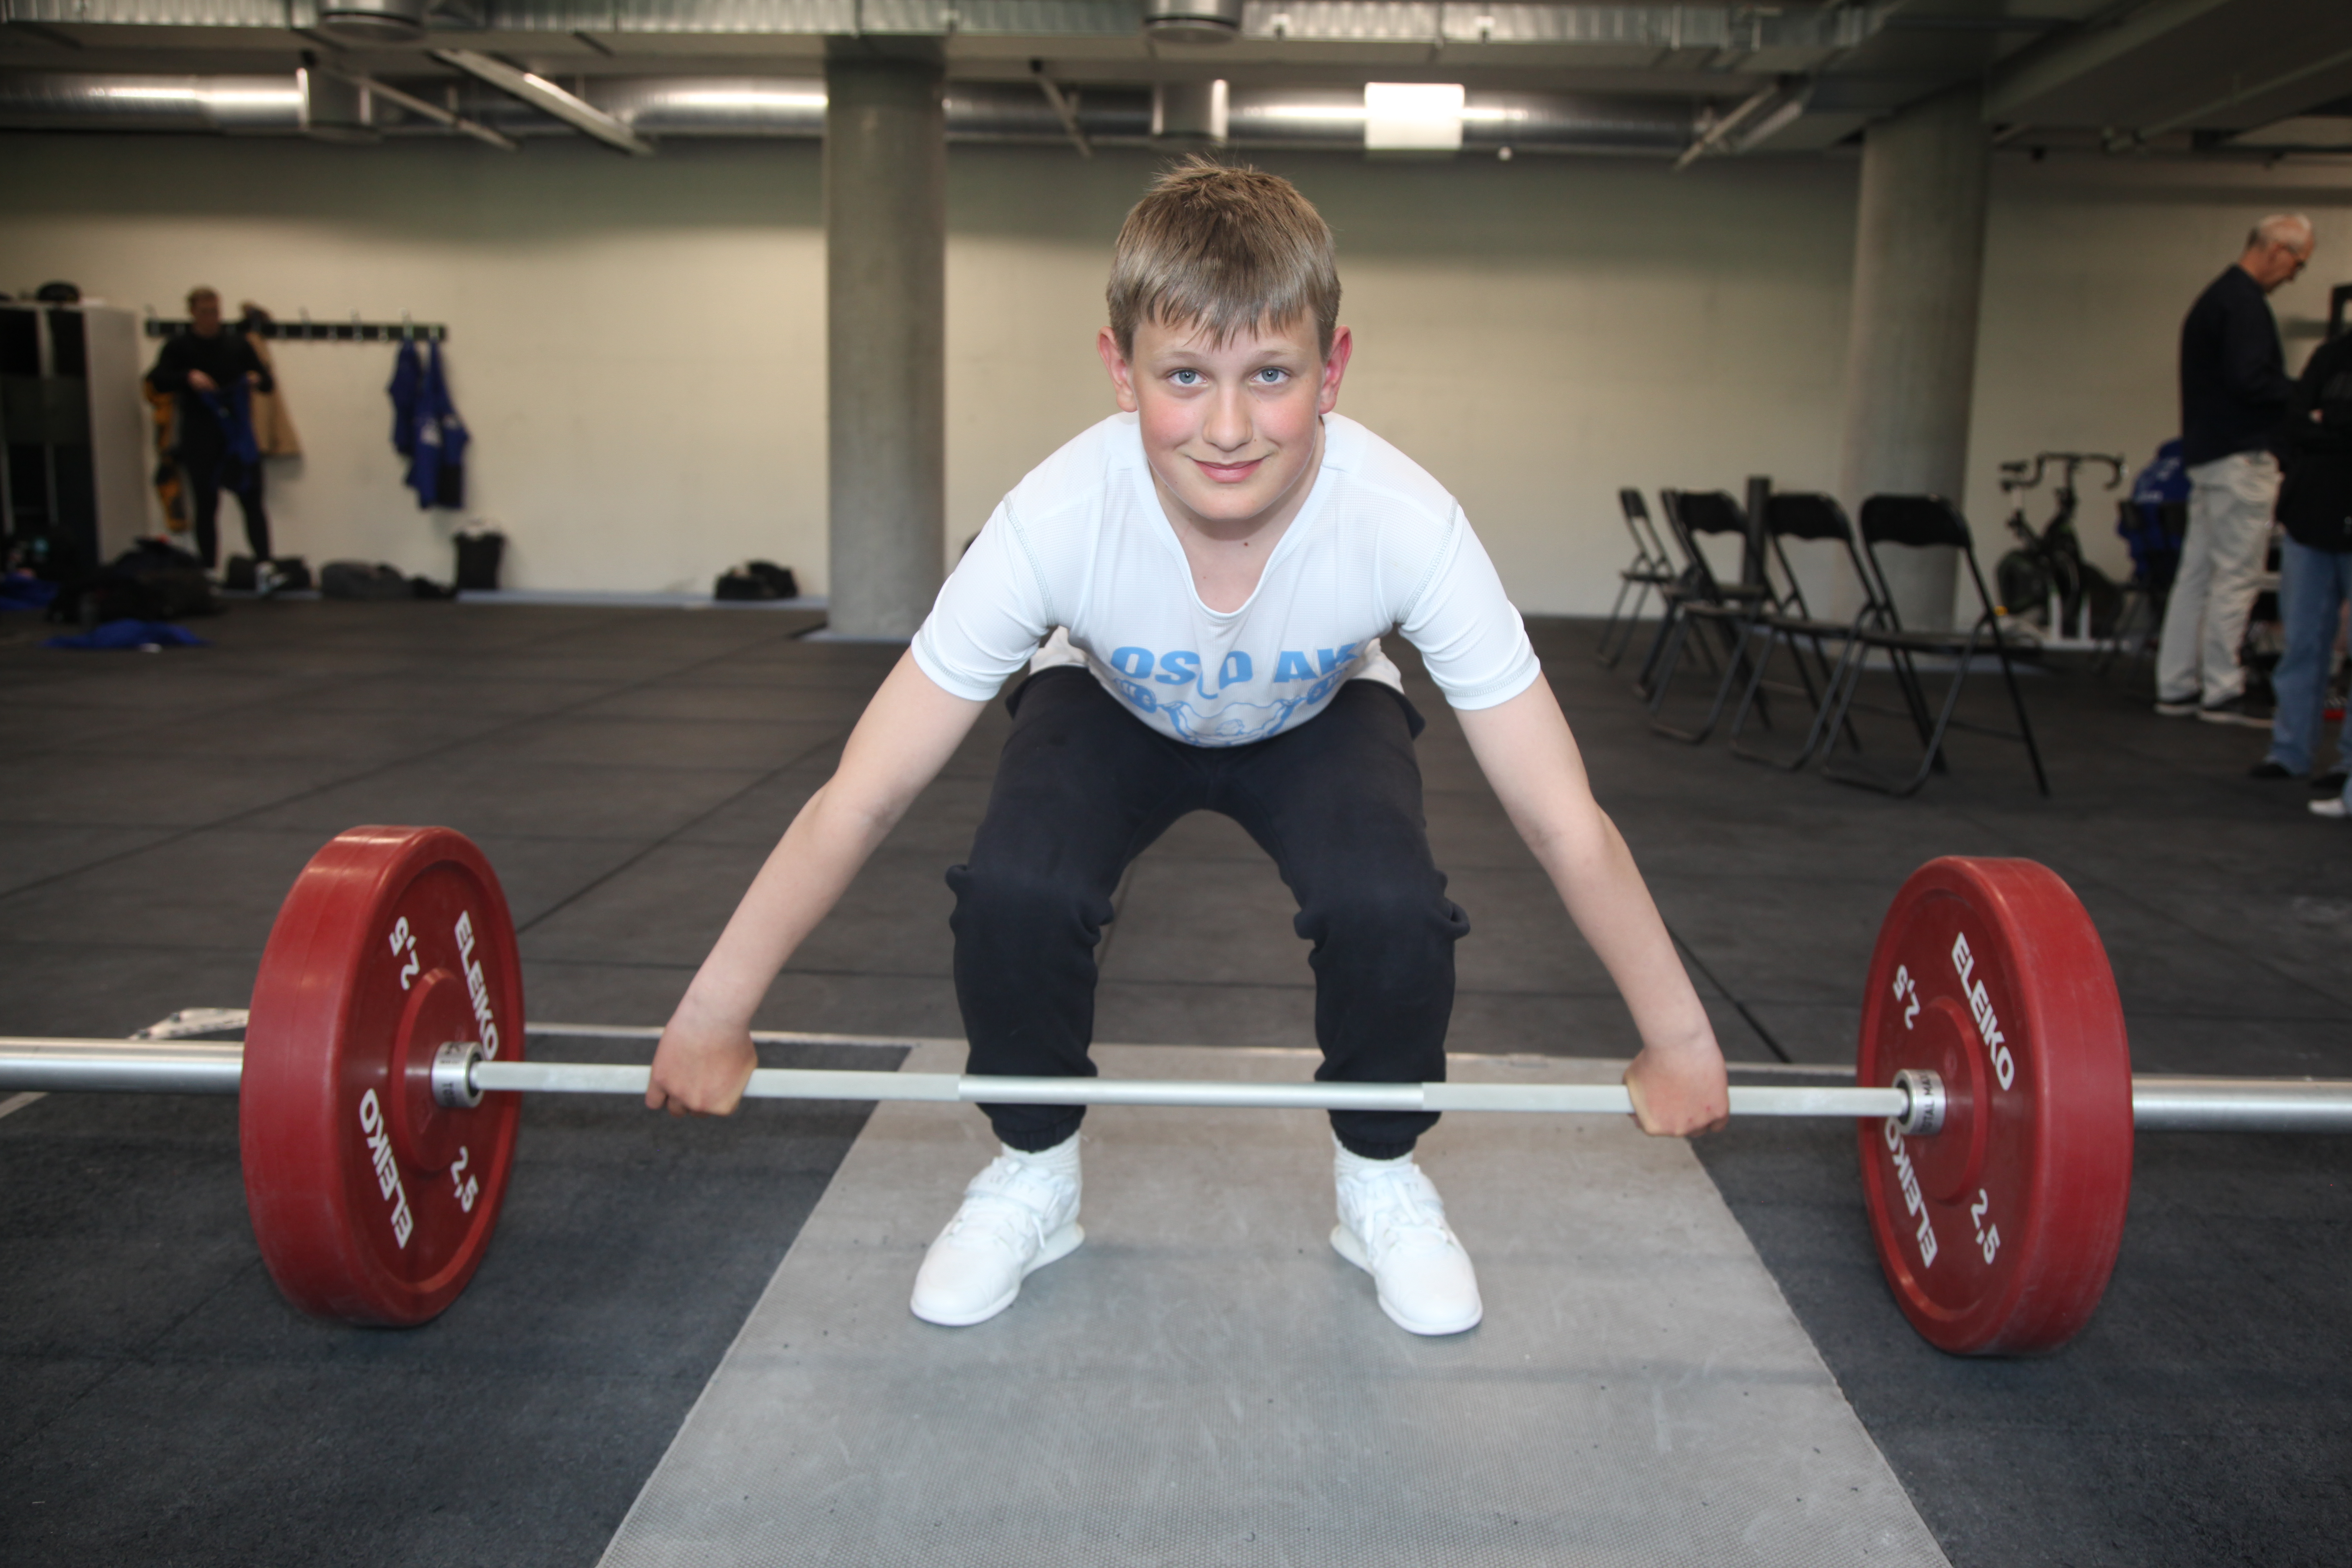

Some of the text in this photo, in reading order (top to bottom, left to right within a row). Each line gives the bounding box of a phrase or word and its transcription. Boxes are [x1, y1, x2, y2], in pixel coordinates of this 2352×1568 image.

[454, 910, 499, 1061] ELEIKO
[1951, 931, 2015, 1091] ELEIKO
[359, 1088, 414, 1250] ELEIKO
[1885, 1116, 1938, 1269] ELEIKO
